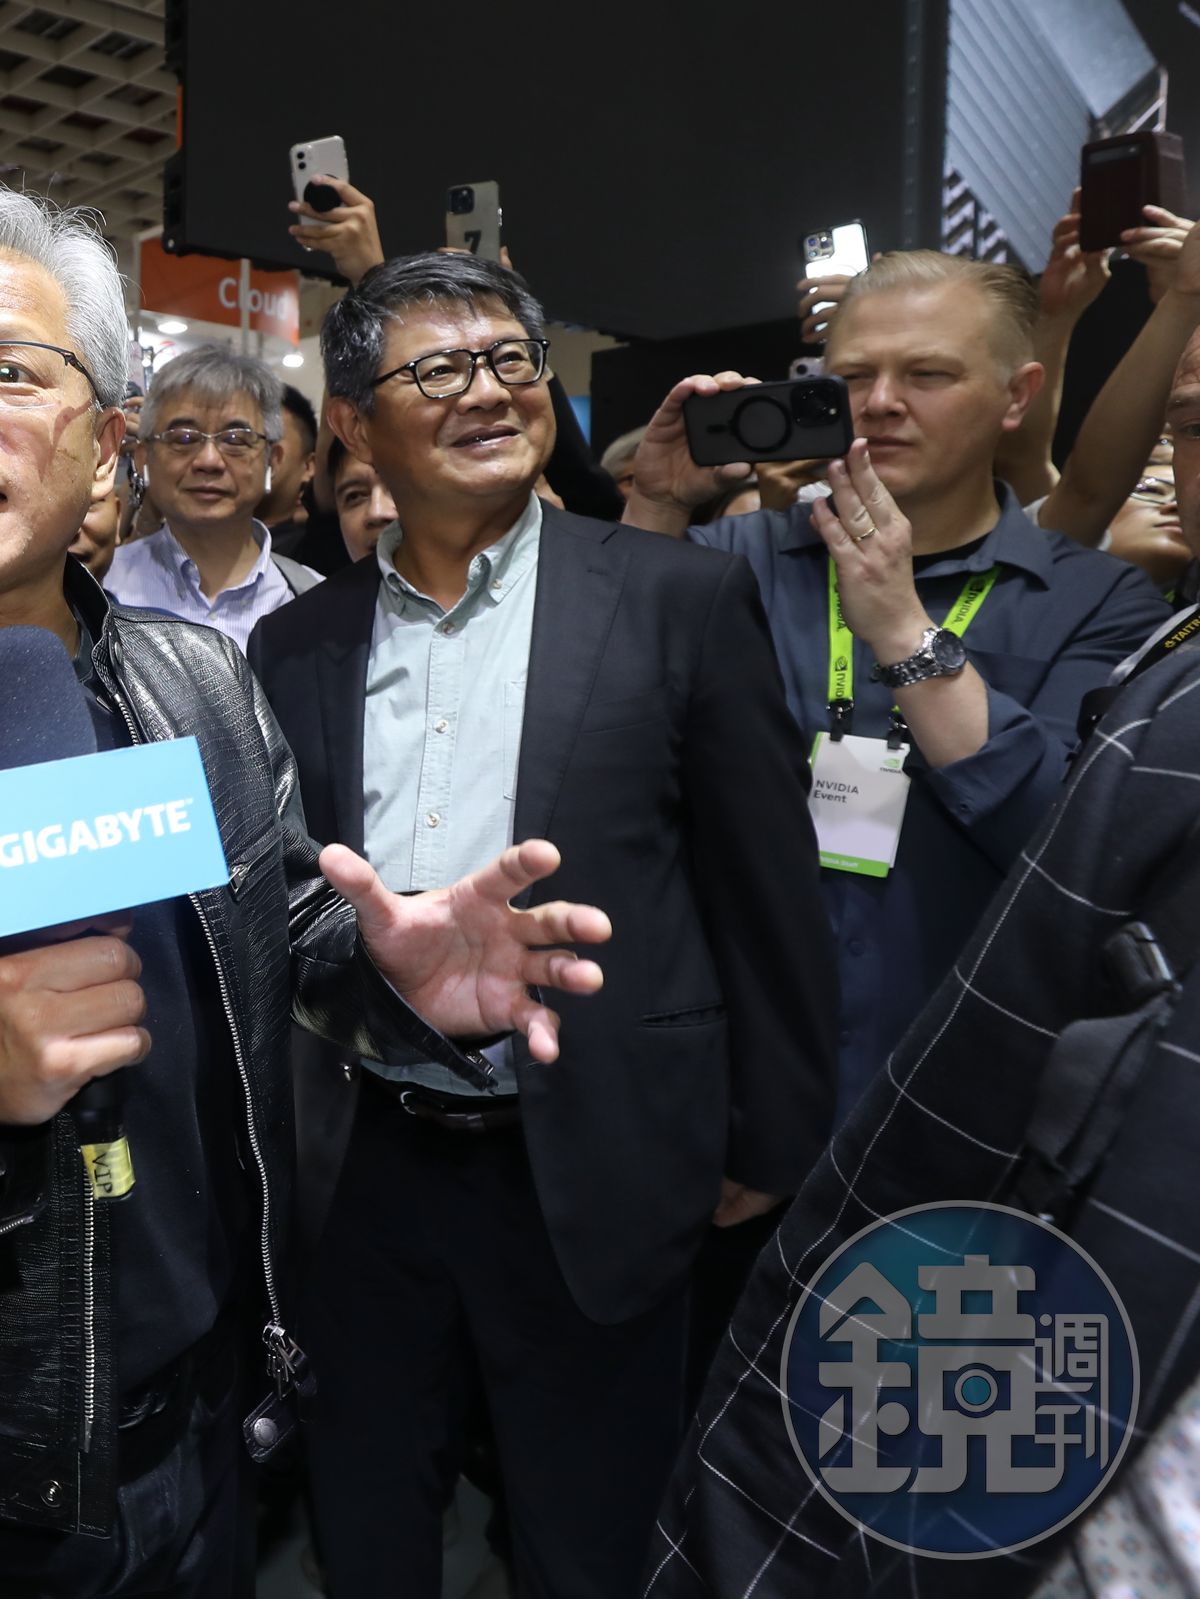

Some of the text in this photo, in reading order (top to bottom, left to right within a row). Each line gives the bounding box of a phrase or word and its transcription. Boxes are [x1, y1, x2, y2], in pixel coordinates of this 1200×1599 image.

[219, 277, 289, 320] Cloud
[813, 789, 847, 804] Event
[815, 779, 860, 795] NVIDIA
[92, 1152, 113, 1194] VIP
